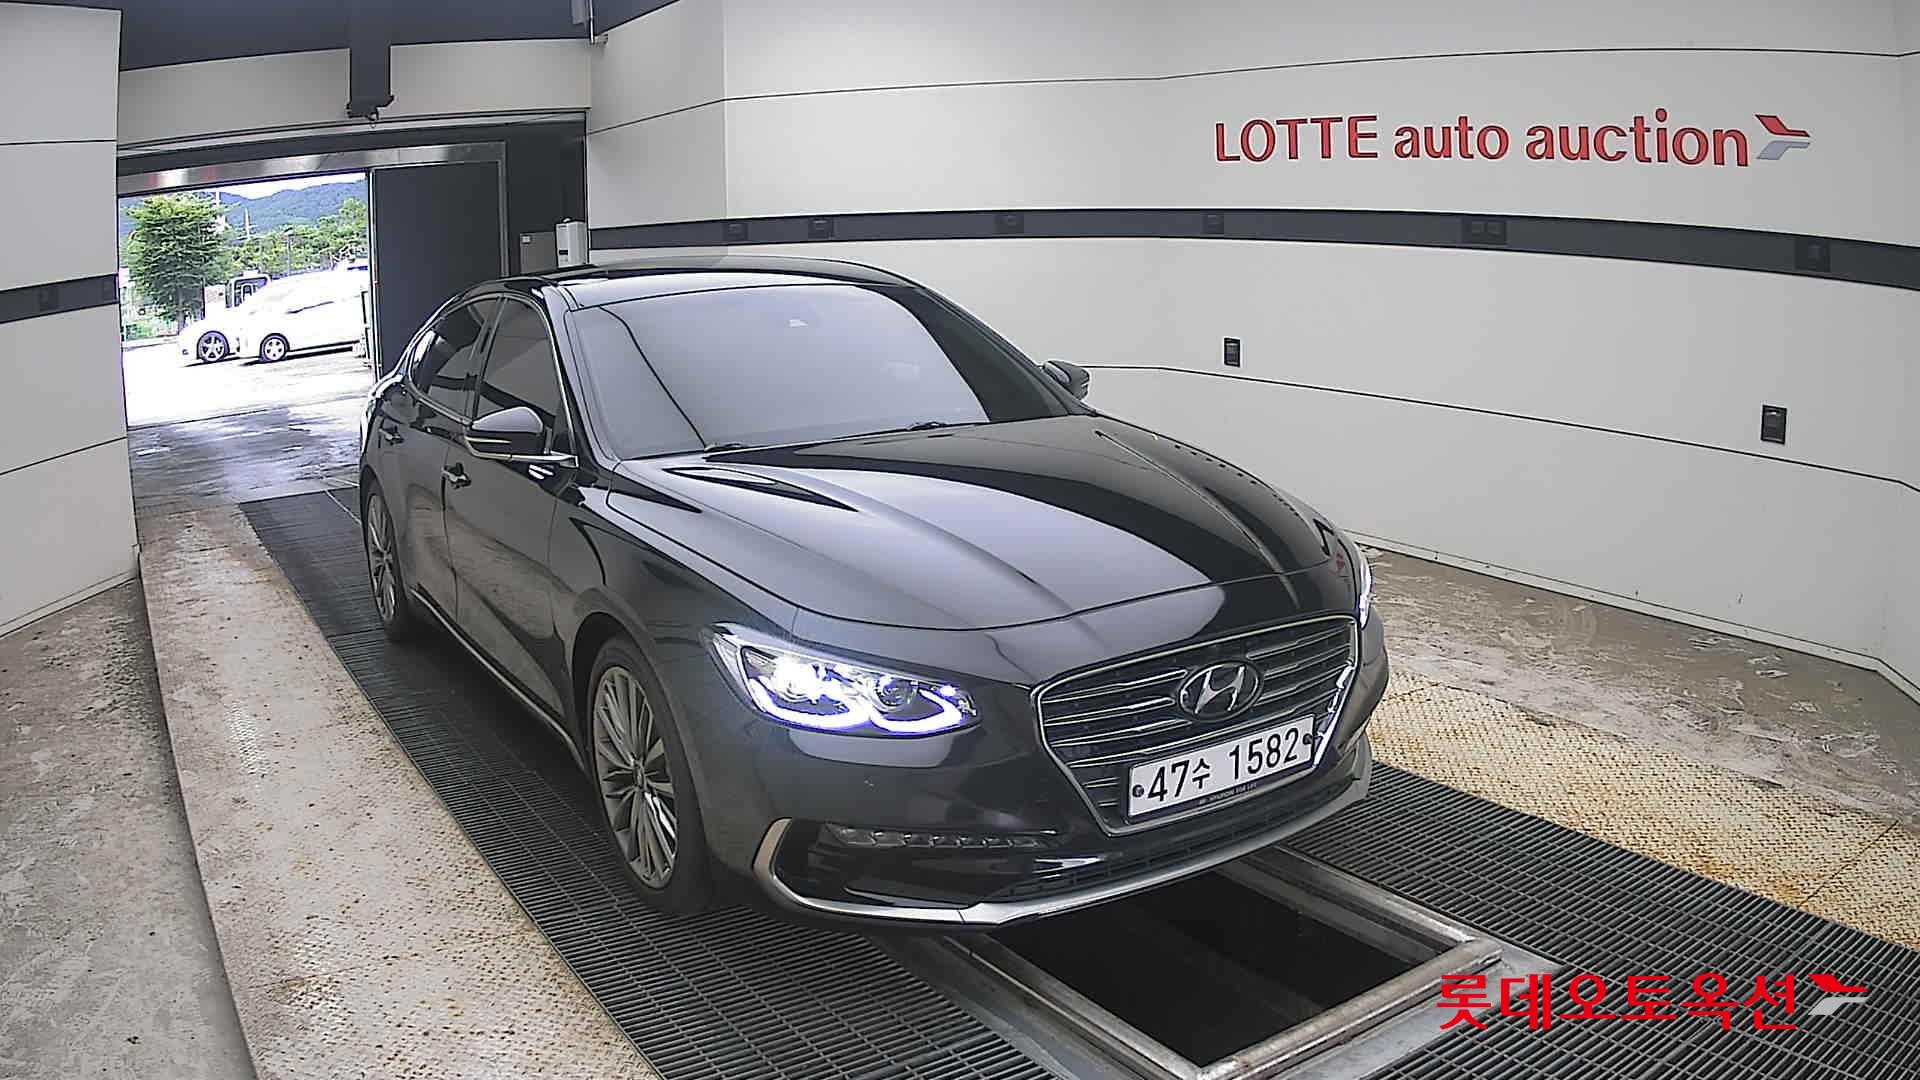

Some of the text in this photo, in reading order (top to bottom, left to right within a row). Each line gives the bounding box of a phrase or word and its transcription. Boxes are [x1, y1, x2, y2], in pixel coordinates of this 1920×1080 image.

[1214, 108, 1750, 167] LOTTE auto auction
[1147, 758, 1210, 802] 47수
[1229, 727, 1299, 780] 1582
